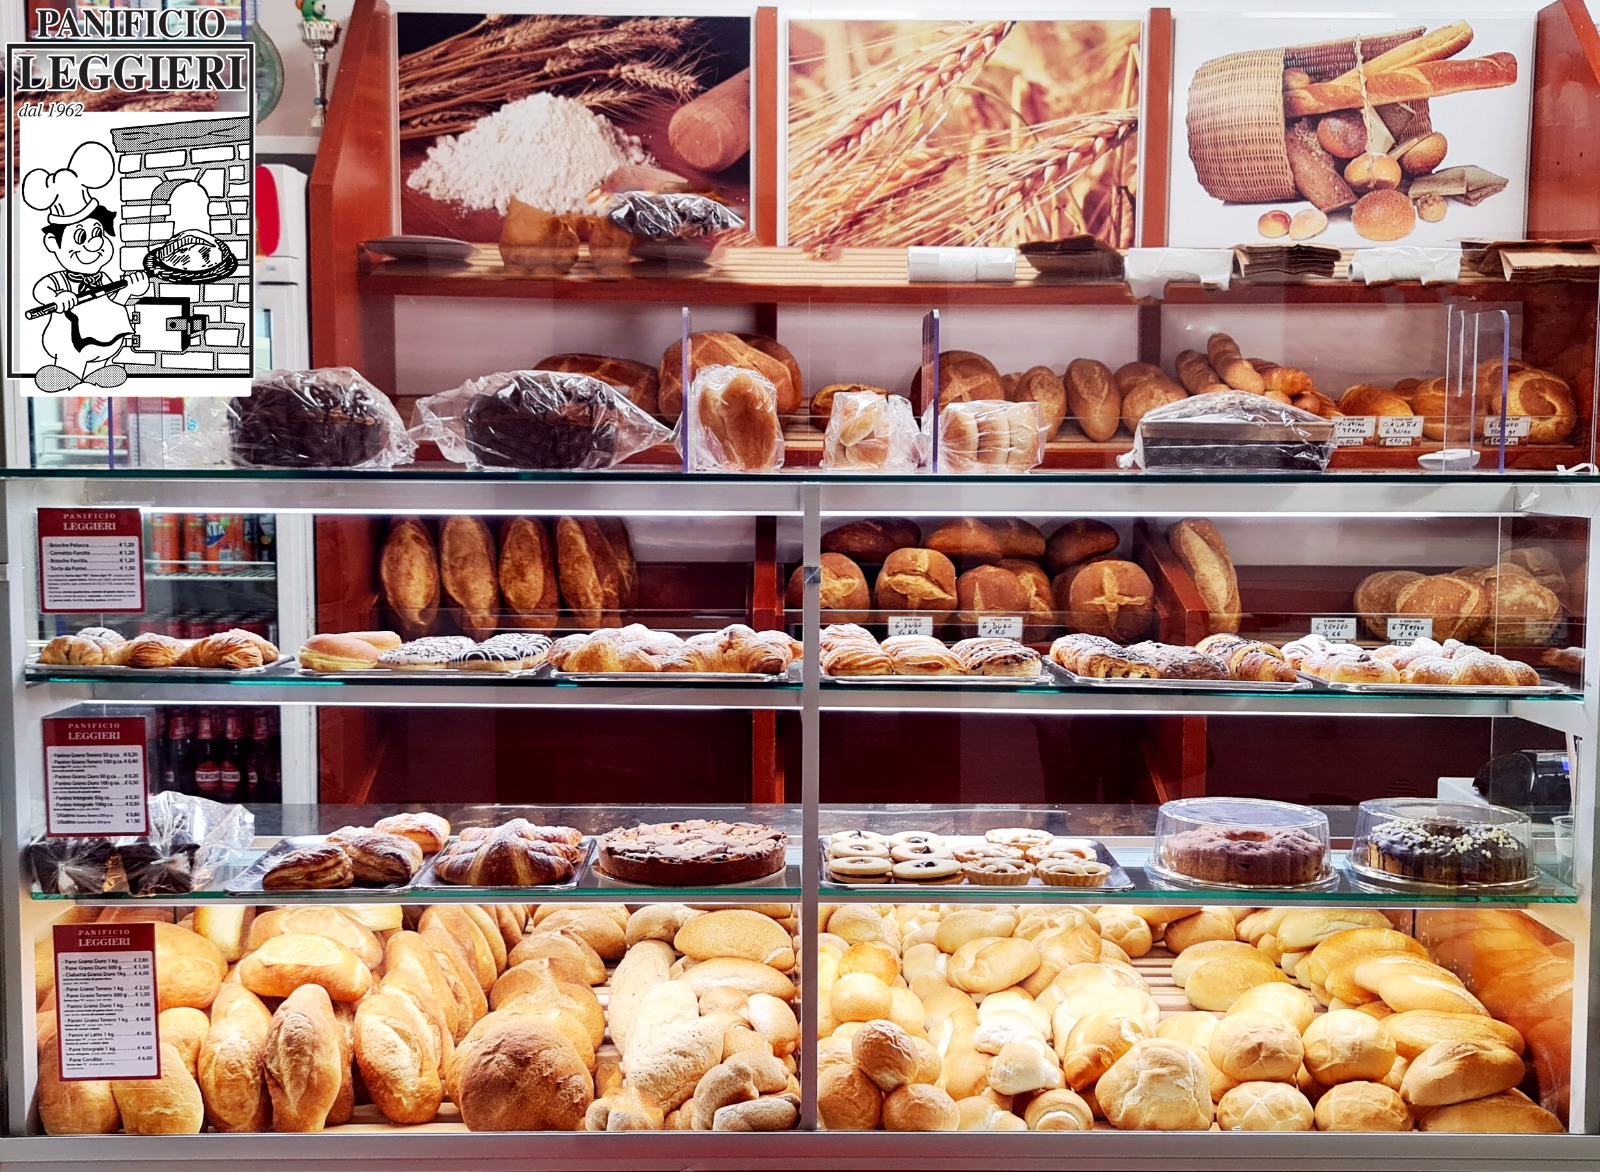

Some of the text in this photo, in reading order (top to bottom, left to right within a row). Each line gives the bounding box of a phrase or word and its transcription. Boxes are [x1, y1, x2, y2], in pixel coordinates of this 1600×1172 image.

[63, 522, 116, 530] LEGGIERI
[68, 732, 120, 740] LEGGIERI
[78, 938, 130, 947] LEGGIERI
